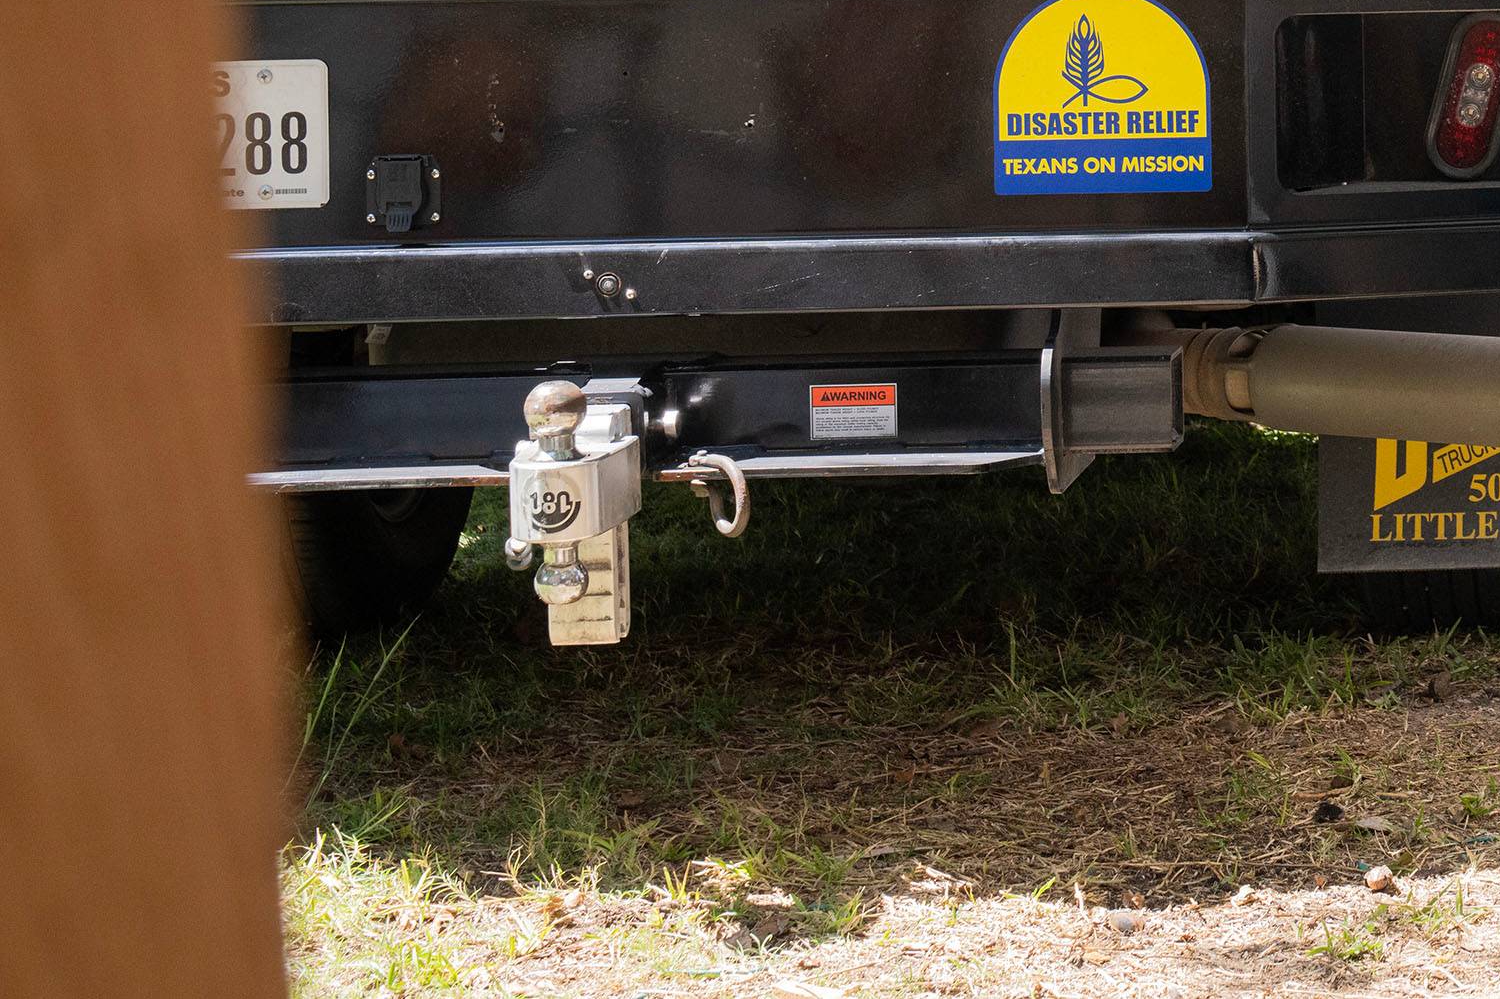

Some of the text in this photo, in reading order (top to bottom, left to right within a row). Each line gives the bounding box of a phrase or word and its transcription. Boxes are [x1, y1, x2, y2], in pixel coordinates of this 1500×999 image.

[1007, 110, 1199, 136] DISASTER RELIEF
[212, 110, 308, 176] 288
[1003, 155, 1205, 175] TEXANS ON MISSION
[829, 390, 887, 402] WARNING
[1370, 511, 1499, 542] LITTLE
